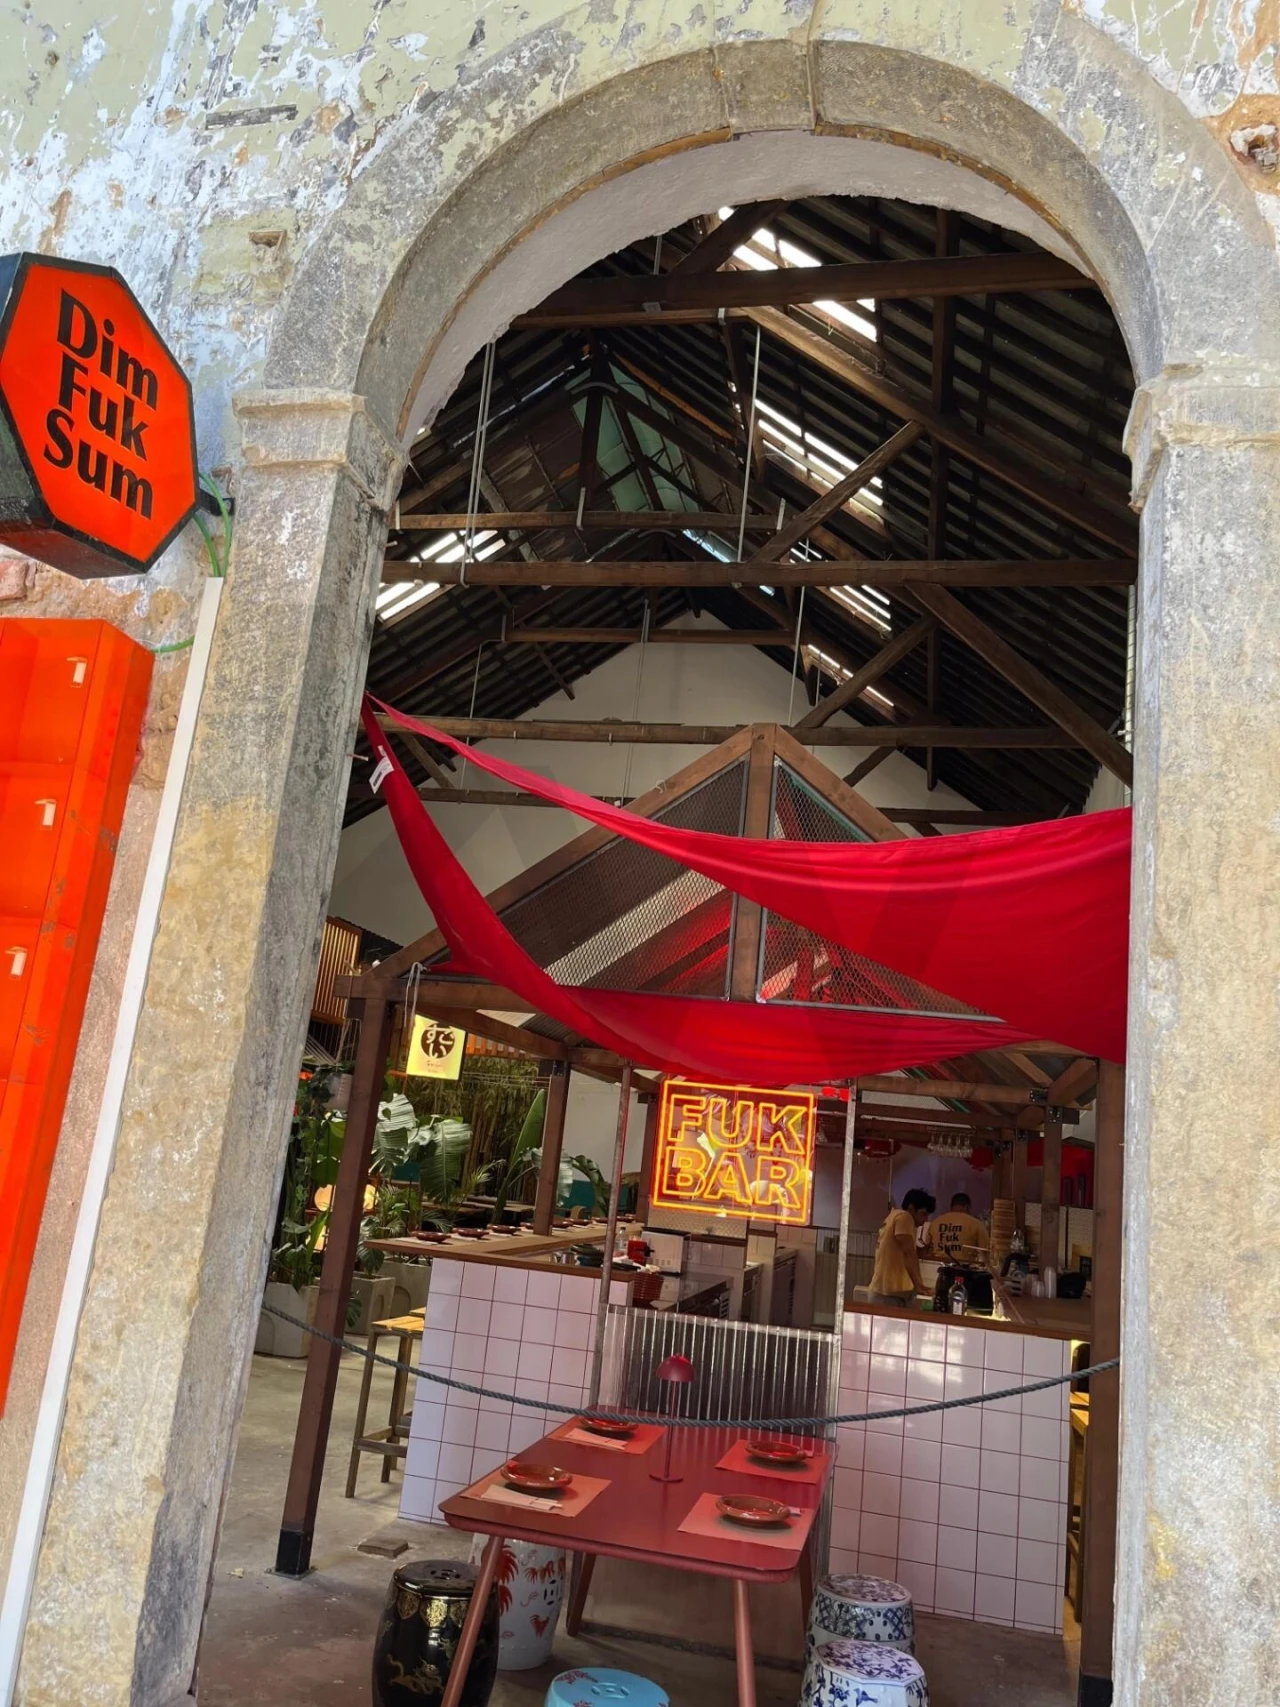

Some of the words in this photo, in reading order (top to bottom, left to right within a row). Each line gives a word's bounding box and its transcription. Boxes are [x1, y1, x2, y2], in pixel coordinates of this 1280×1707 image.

[57, 289, 158, 411] Dim
[58, 351, 149, 461] Fuk
[43, 408, 153, 520] Sum
[668, 1094, 807, 1154] FUK
[662, 1146, 802, 1208] BAR
[938, 1223, 962, 1232] Dim
[939, 1232, 959, 1242] Fuk
